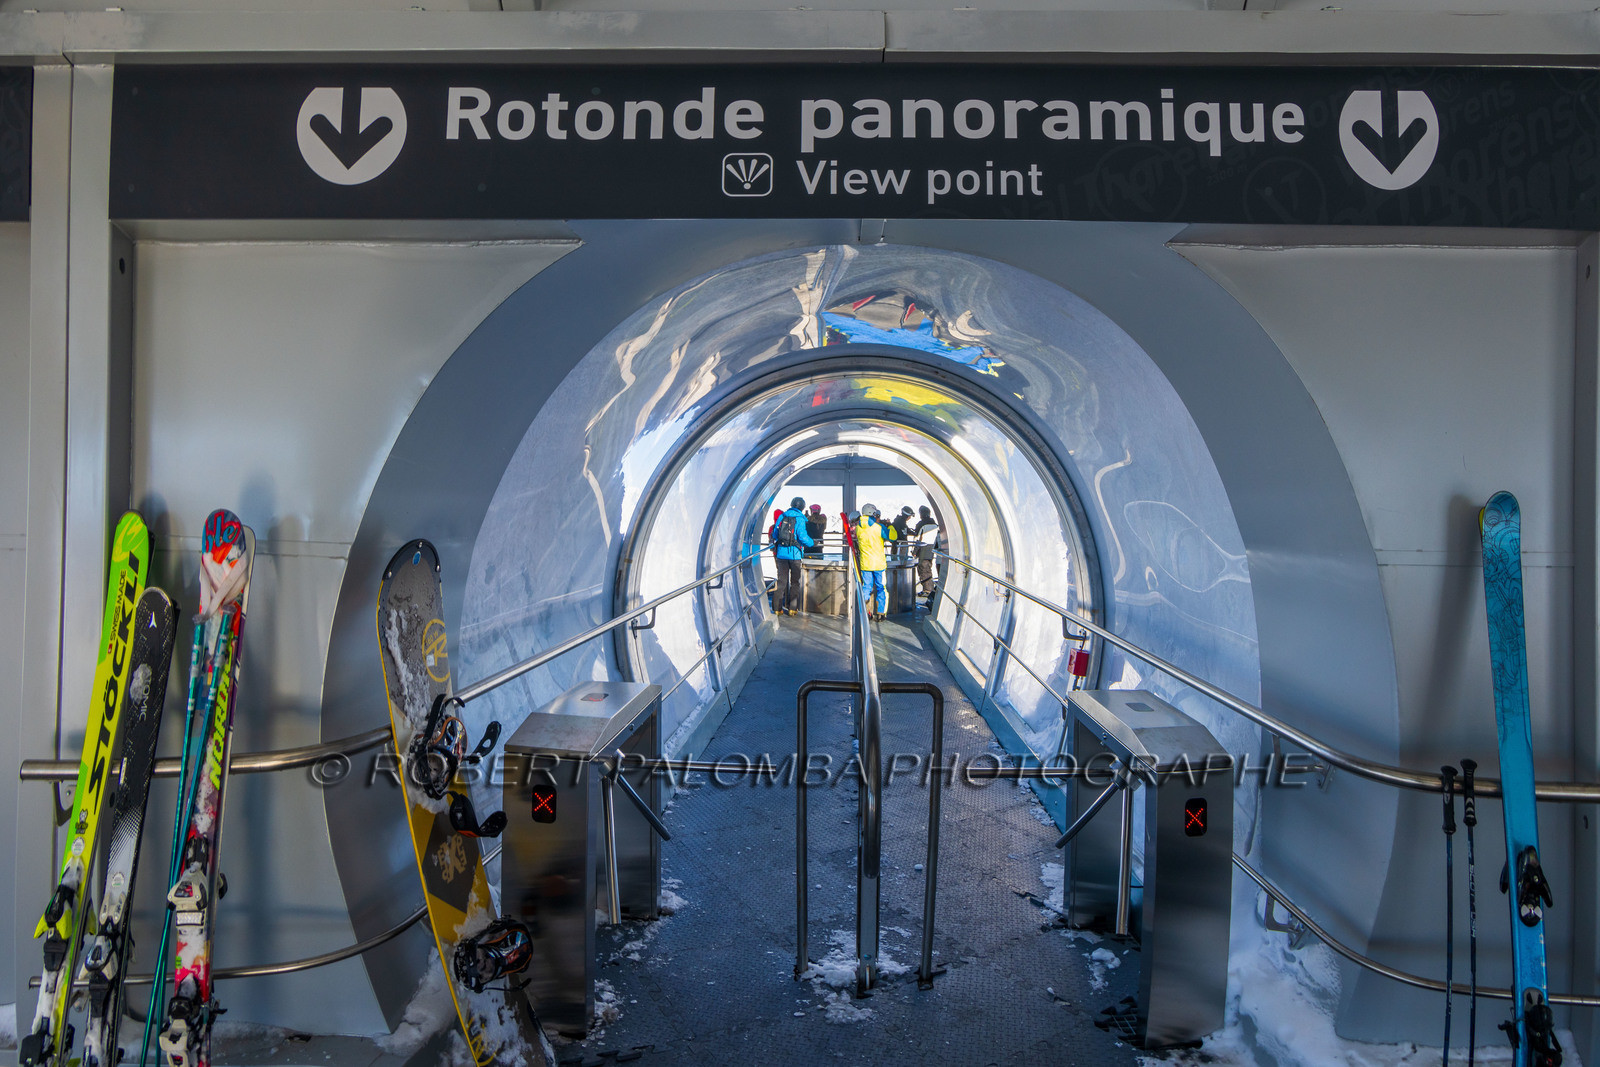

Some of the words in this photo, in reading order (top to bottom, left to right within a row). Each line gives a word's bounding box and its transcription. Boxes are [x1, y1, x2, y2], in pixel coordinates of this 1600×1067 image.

[445, 86, 765, 141] Rotonde
[799, 88, 1305, 157] panoramique
[795, 159, 911, 195] View
[927, 160, 1043, 205] point
[109, 606, 122, 642] SWISS
[116, 569, 127, 606] MADE
[88, 549, 140, 816] STÖCKLI
